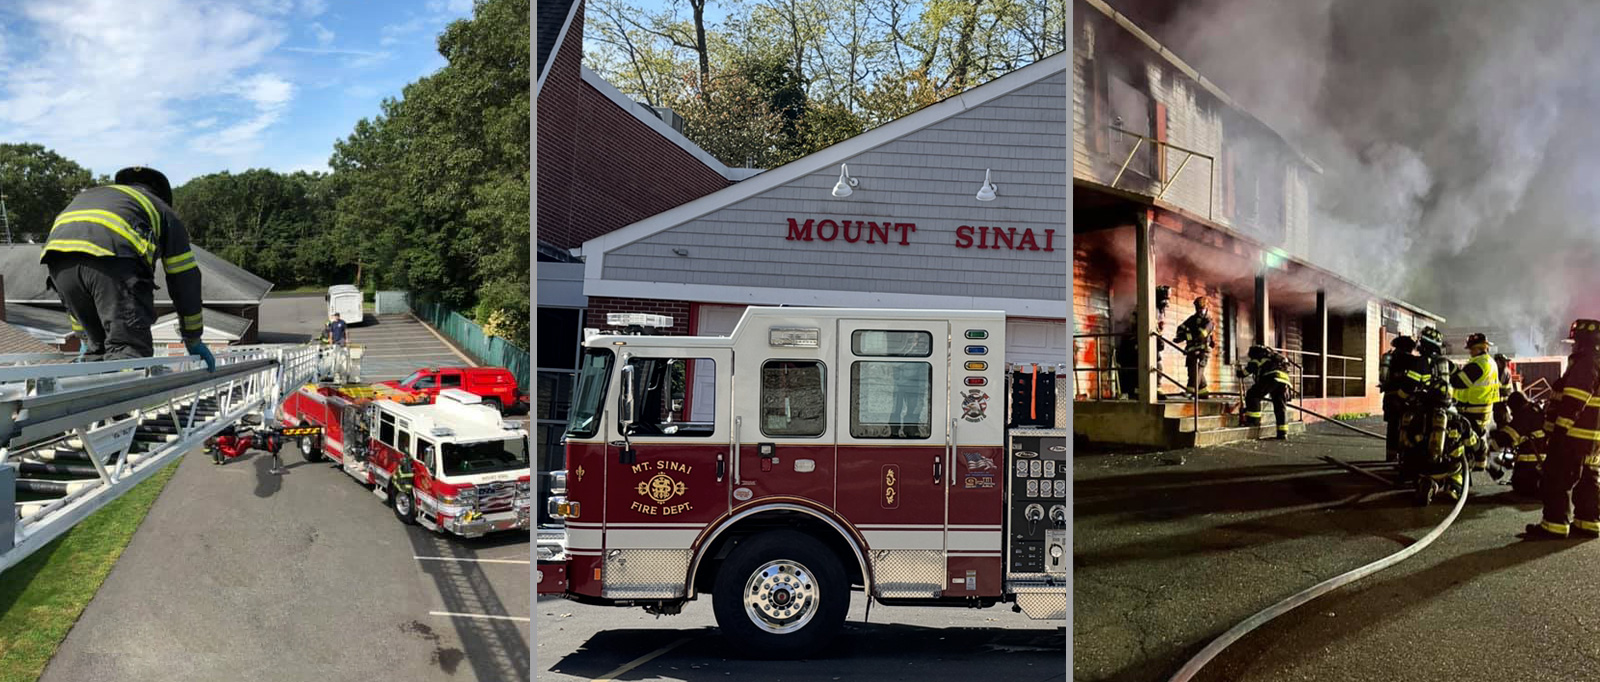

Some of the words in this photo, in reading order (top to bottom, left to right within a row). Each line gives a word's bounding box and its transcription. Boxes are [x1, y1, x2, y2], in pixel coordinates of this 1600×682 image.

[785, 218, 916, 246] MOUNT
[955, 225, 1055, 252] SINAI
[631, 461, 653, 474] MT.
[656, 460, 693, 475] SINAI
[630, 501, 658, 516] FIRE
[662, 501, 693, 516] DEPT.
